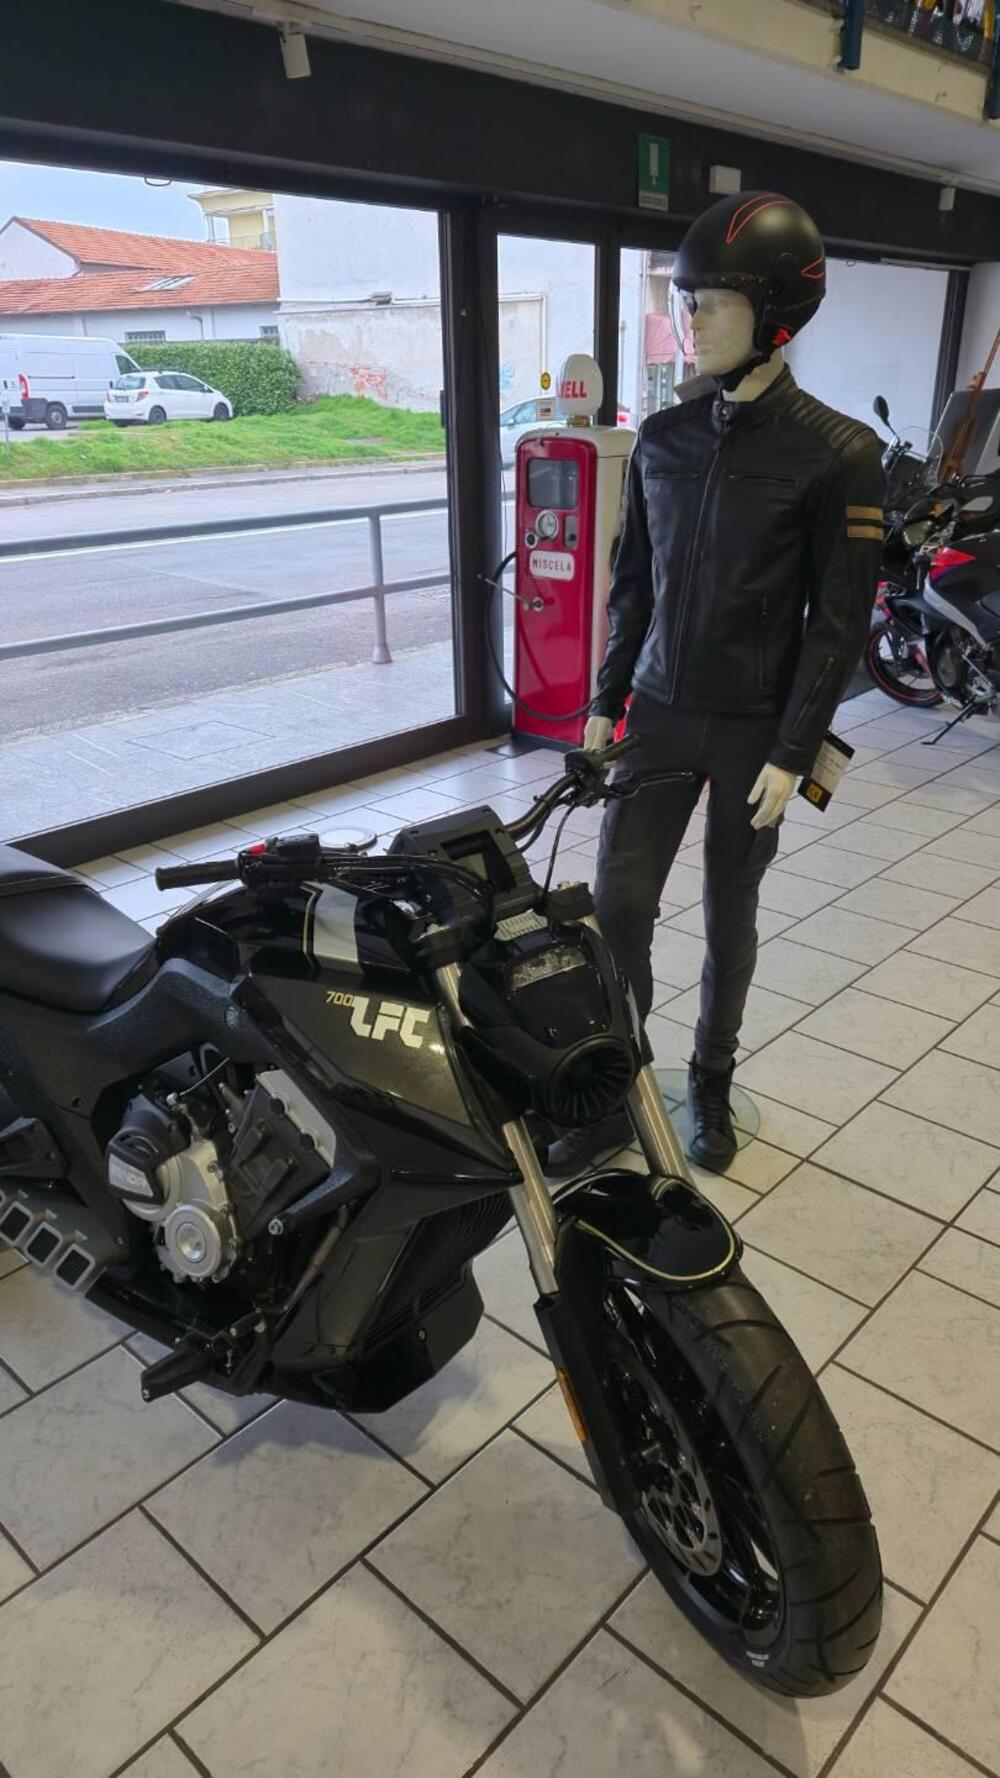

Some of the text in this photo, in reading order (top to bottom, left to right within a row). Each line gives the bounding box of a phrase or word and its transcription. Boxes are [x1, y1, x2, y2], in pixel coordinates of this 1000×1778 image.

[531, 558, 572, 572] MISCELA
[326, 990, 431, 1049] 700 LFC
